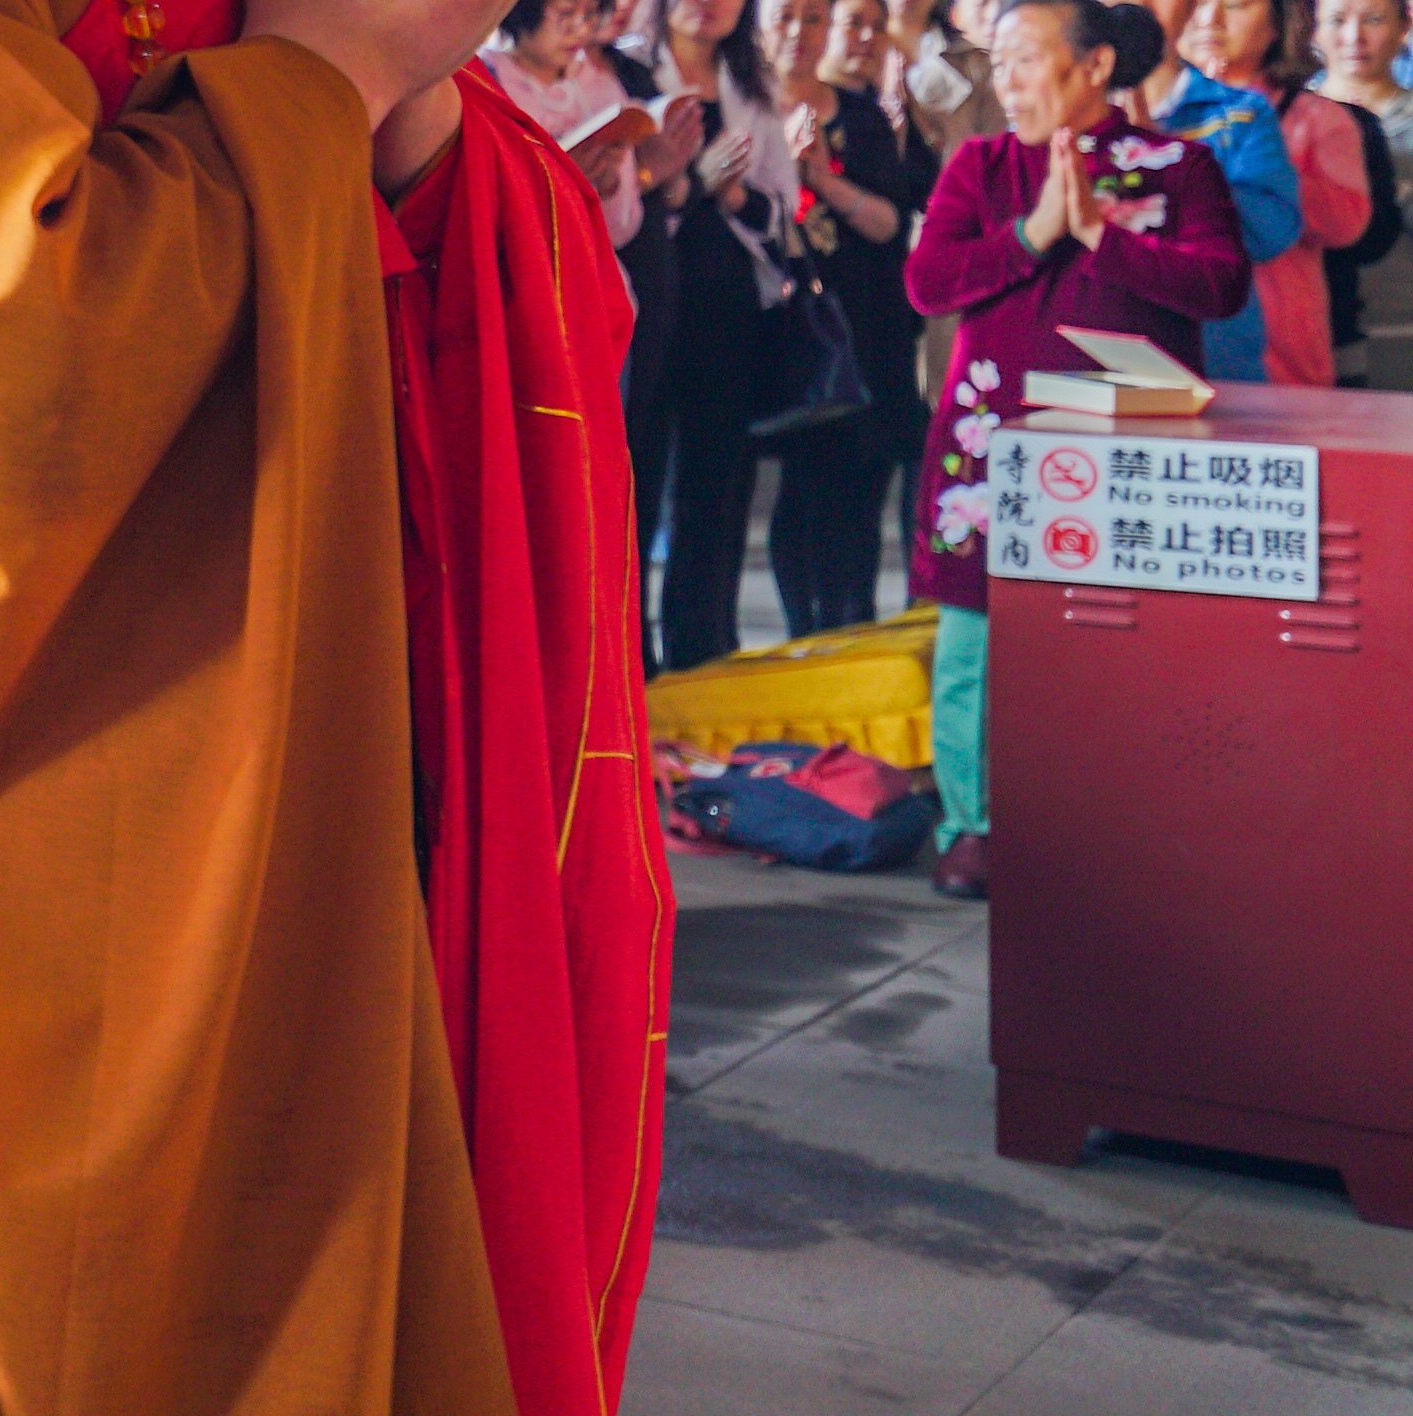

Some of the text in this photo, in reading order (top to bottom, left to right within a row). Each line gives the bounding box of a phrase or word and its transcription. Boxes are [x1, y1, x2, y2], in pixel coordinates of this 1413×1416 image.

[1109, 448, 1304, 489] 禁止吸烟
[997, 444, 1034, 569] 寺院内
[1109, 486, 1305, 519] No smoking
[1111, 518, 1306, 561] 禁止拍照
[1113, 553, 1305, 583] No photos
